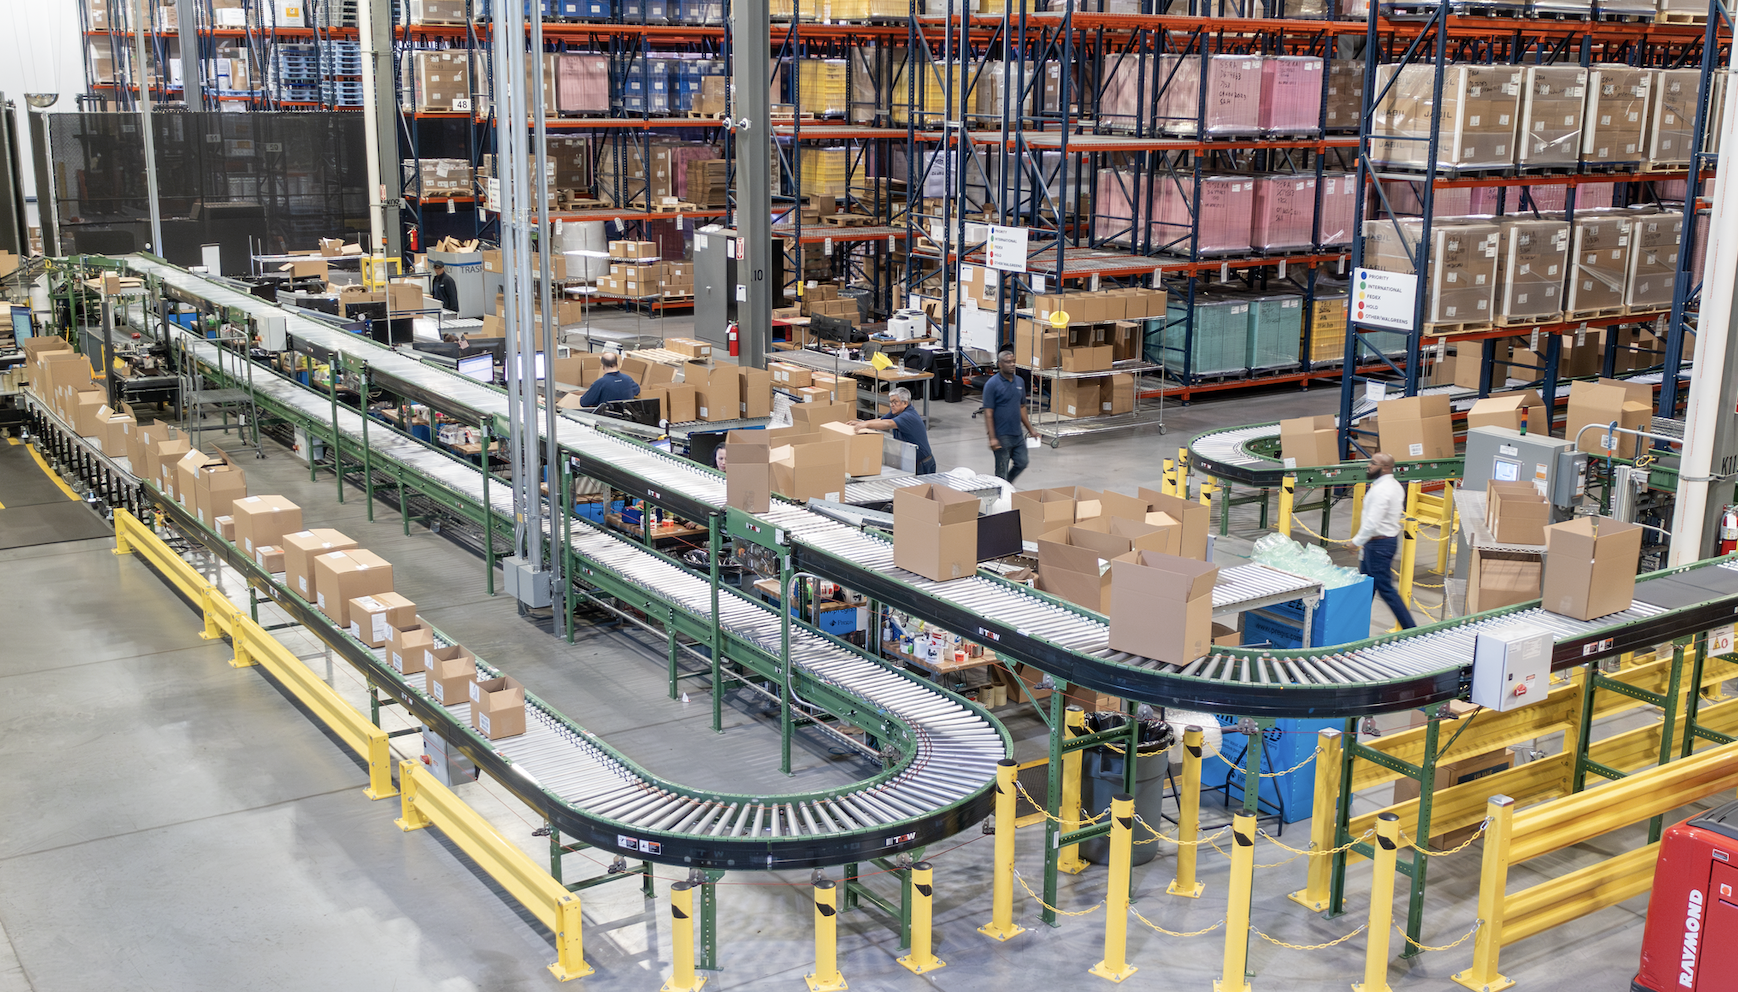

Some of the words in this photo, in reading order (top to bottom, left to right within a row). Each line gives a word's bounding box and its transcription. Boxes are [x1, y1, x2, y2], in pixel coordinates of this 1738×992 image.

[1384, 76, 1412, 85] JBIL
[457, 100, 467, 109] 48
[1378, 141, 1405, 149] JABIL
[1367, 284, 1402, 293] INTERNATIONAL
[1365, 313, 1408, 325] OTHER/WALGREENS
[894, 831, 916, 844] TGW
[1678, 888, 1704, 989] RAYMOND
